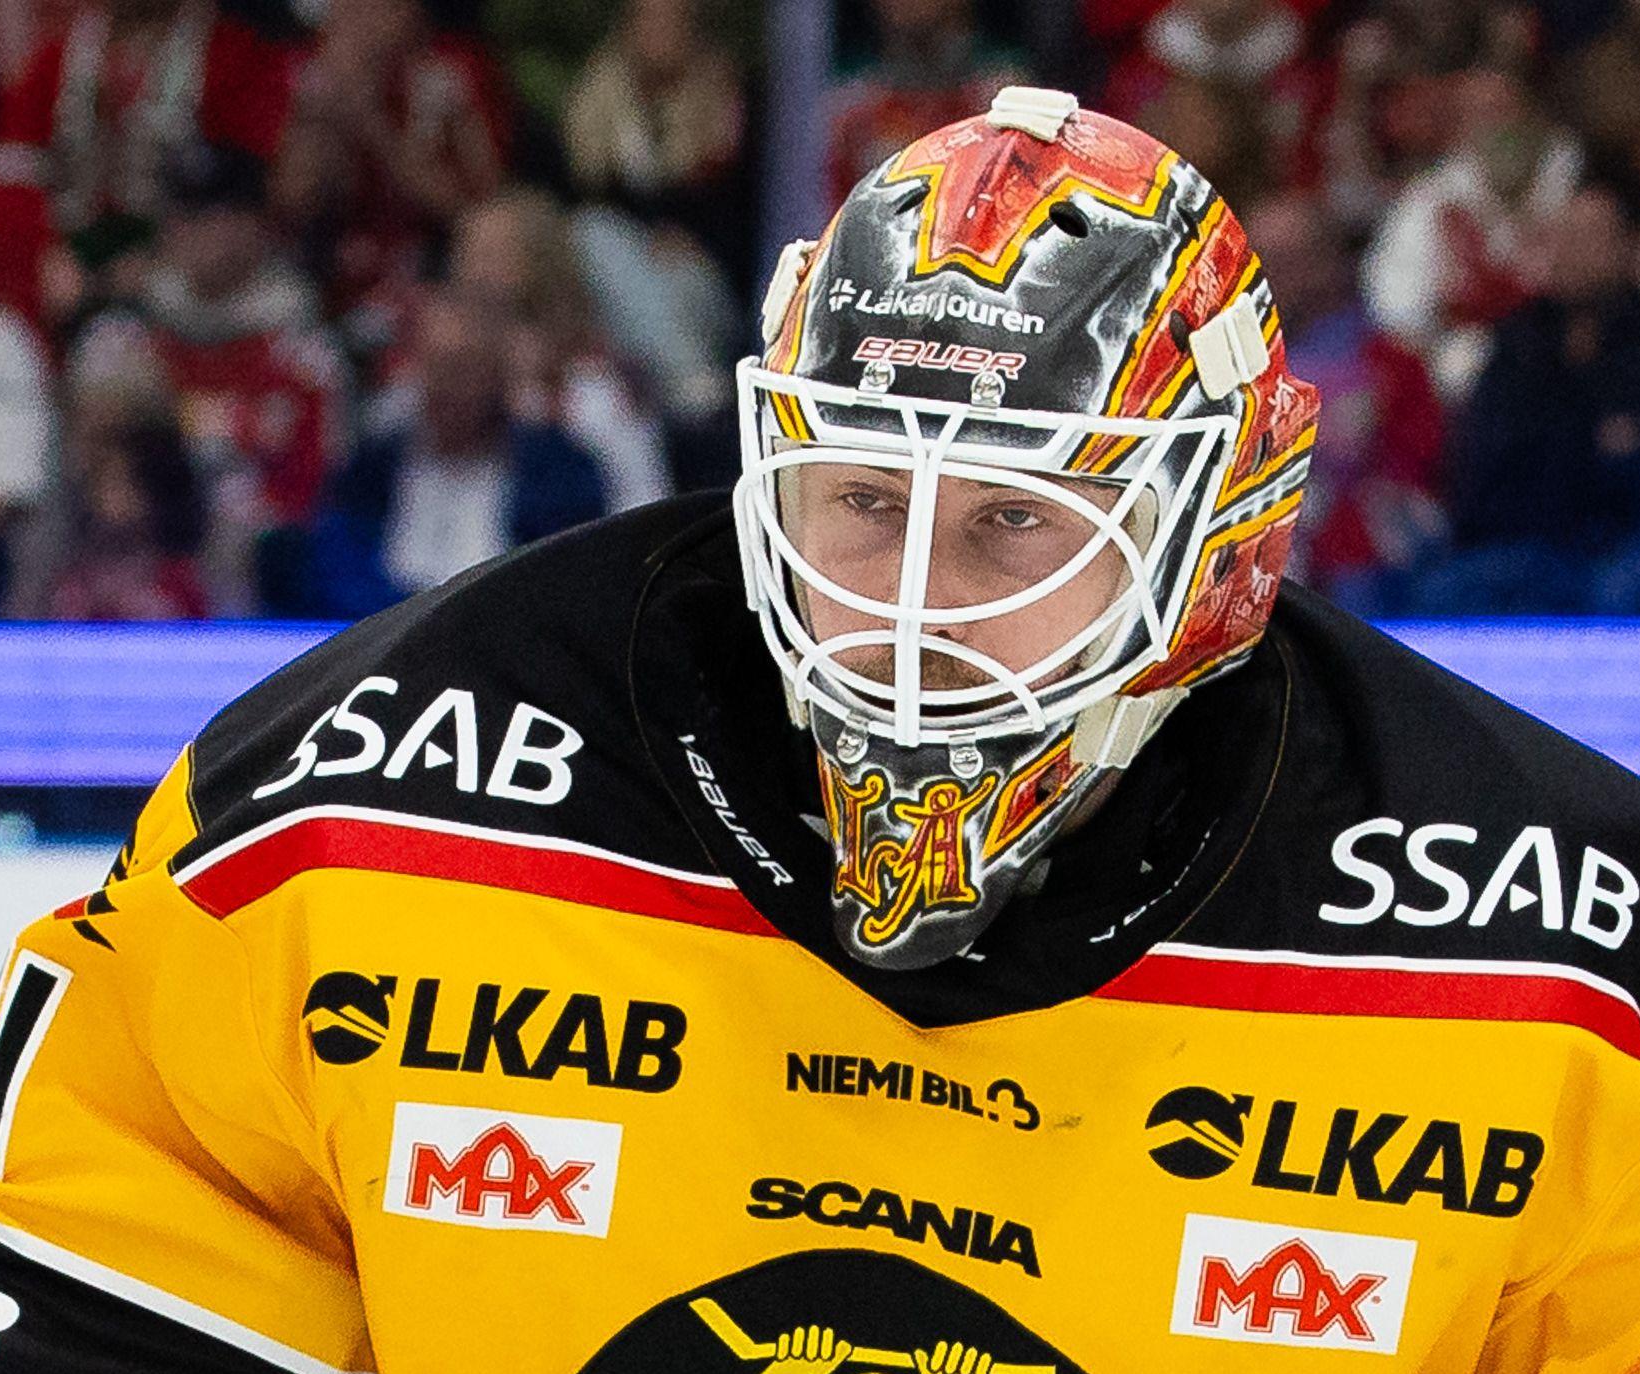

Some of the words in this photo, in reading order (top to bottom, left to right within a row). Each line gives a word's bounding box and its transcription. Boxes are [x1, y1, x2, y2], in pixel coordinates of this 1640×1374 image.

[855, 288, 1046, 334] Läkarjouren
[1319, 817, 1640, 950] SSAB
[400, 976, 688, 1093] LKAB
[786, 1052, 914, 1102] NIEMI
[405, 1120, 596, 1226] MAX
[1253, 1098, 1546, 1219] LKAB
[745, 1176, 1042, 1279] SCANIA
[1193, 1237, 1388, 1343] MAX
